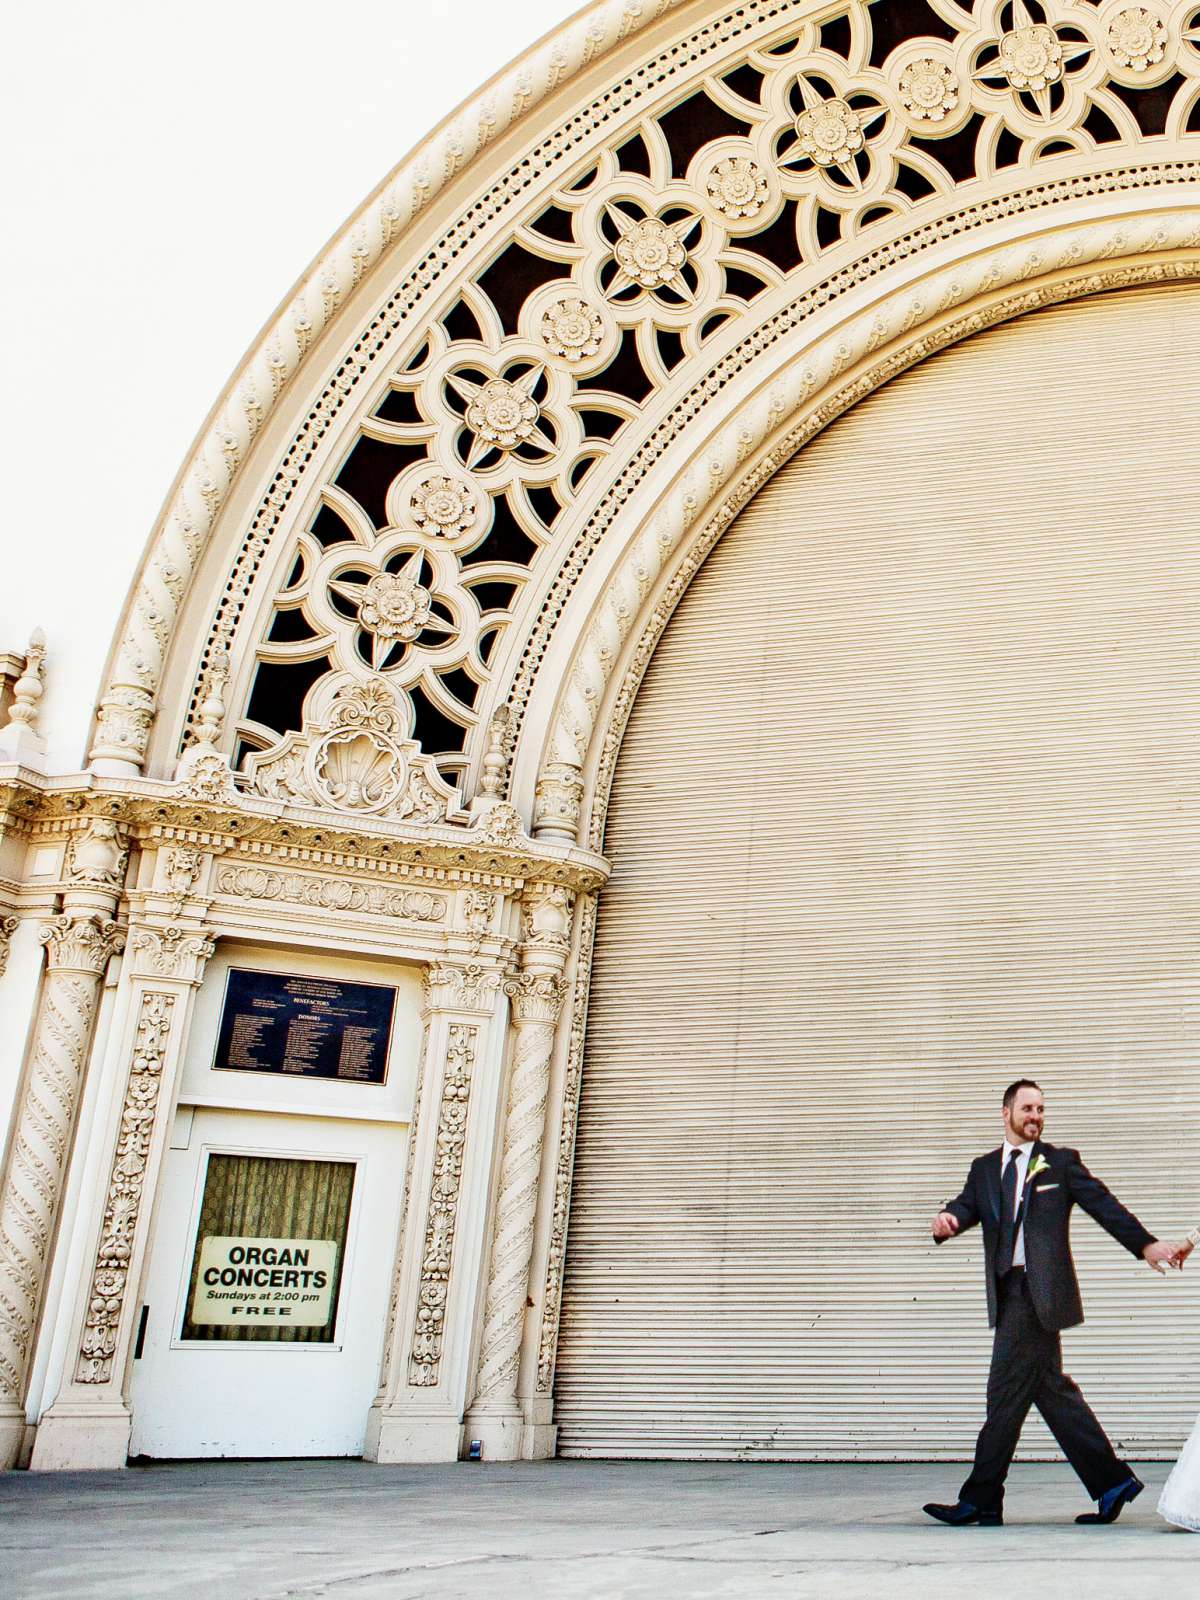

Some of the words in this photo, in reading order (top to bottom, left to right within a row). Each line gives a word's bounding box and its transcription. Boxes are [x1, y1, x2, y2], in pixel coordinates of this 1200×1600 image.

[293, 998, 329, 1006] BENEFACTORS
[229, 1246, 310, 1266] ORGAN
[204, 1268, 327, 1288] CONCERTS
[207, 1290, 256, 1301] Sundays
[259, 1292, 270, 1300] at
[273, 1292, 298, 1301] 2:00
[301, 1294, 319, 1302] pm
[232, 1307, 292, 1315] FREE
